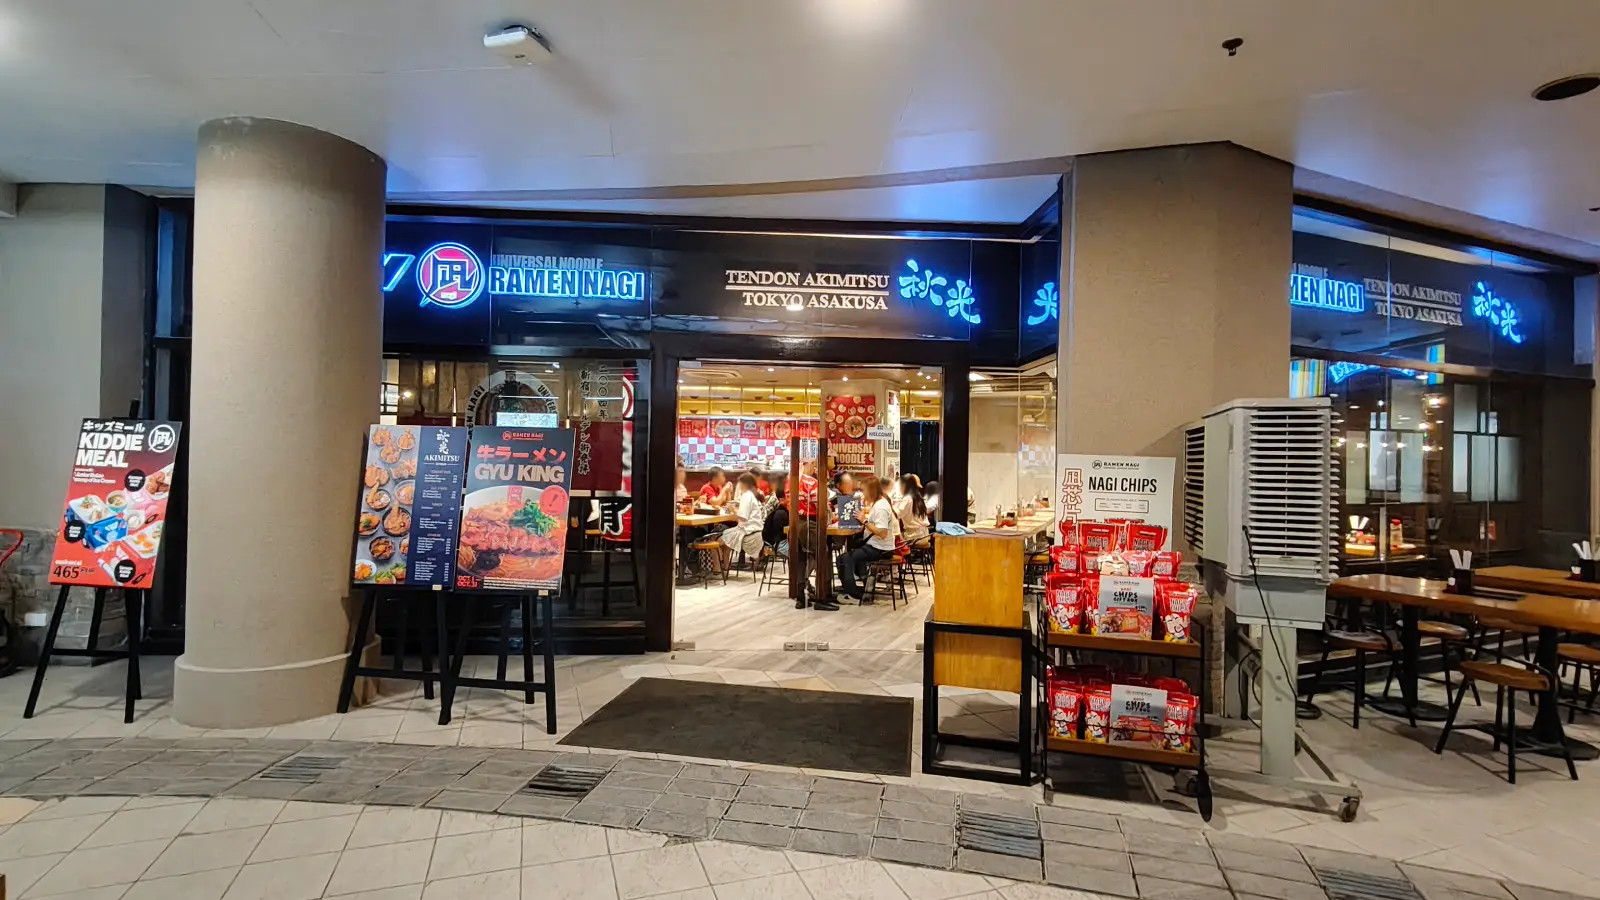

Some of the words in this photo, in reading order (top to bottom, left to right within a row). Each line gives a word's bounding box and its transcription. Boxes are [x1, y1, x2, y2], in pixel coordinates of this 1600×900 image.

[492, 254, 558, 269] UNIVERSAL
[559, 256, 604, 270] NOODLE
[489, 267, 578, 297] RAMEN
[579, 269, 645, 300] NAGI
[725, 270, 800, 286] TENDON
[802, 272, 890, 288] AKIMITSU
[743, 292, 804, 309] TOKYO
[806, 294, 888, 310] ASAKUSA
[1323, 278, 1364, 312] NAGI
[1363, 278, 1410, 297] TENDON
[1411, 286, 1462, 306] AKIMITSU
[1374, 301, 1414, 319] TOKYO
[1415, 308, 1463, 326] ASAKUSA
[82, 420, 146, 433] キッズミール
[79, 432, 144, 451] KIDDIE
[76, 449, 128, 468] MEAL
[476, 444, 567, 464] 牛ラーメン
[474, 463, 514, 480] GYU
[517, 464, 565, 483] KING
[1088, 476, 1118, 491] NAGI
[1120, 478, 1157, 493] CHIPS
[53, 566, 80, 578] 465
